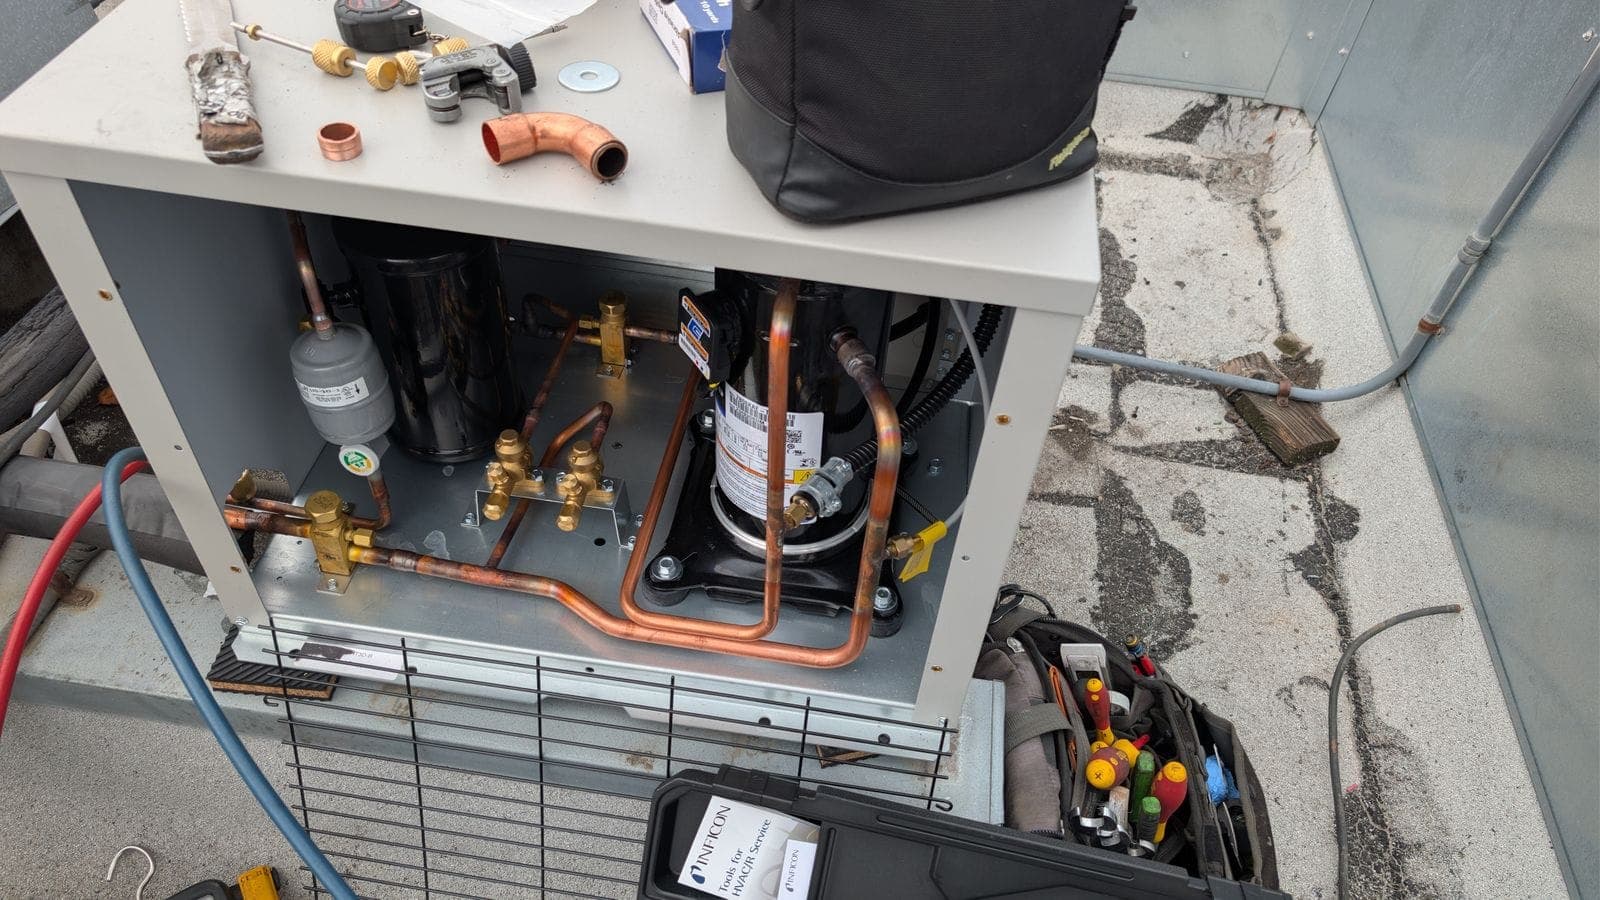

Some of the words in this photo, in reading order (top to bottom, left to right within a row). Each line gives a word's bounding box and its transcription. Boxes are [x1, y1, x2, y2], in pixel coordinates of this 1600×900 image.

[702, 8, 719, 23] yards
[697, 804, 731, 866] INFICON
[732, 855, 755, 897] HVAC/R
[750, 818, 772, 854] Service
[719, 867, 736, 893] Tools
[731, 848, 744, 864] for
[787, 849, 799, 883] INFICON
